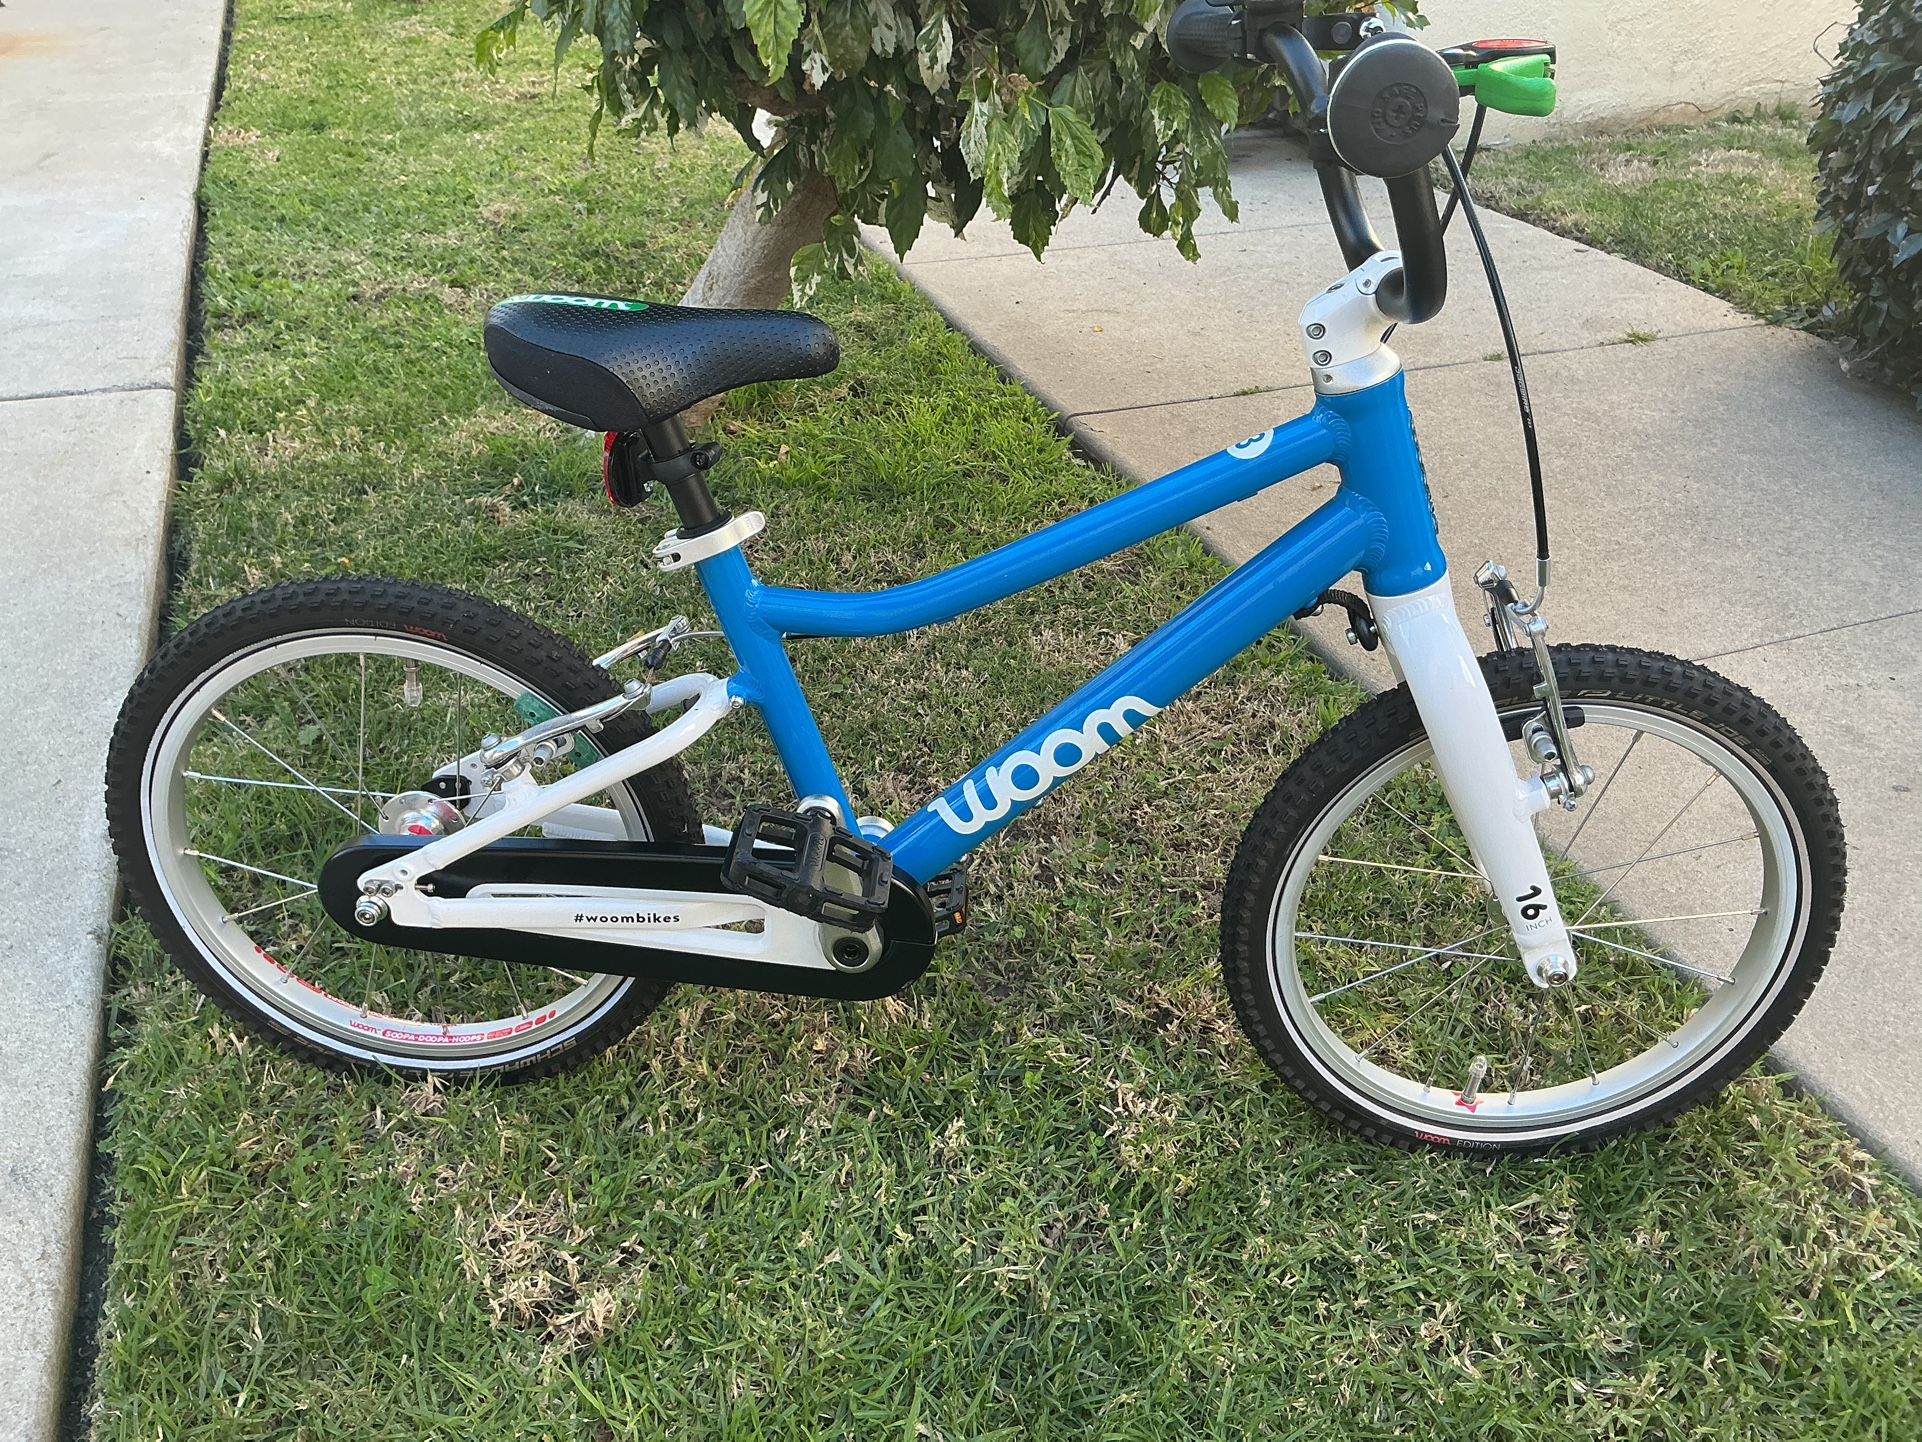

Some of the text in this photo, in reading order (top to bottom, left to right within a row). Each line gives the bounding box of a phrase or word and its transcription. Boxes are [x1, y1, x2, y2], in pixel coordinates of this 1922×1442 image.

[1615, 690, 1751, 747] LITTLE JOE
[926, 695, 1163, 835] woom
[1515, 884, 1548, 921] 16
[573, 912, 681, 924] #woombikes
[1525, 916, 1553, 932] INCH
[1456, 1139, 1501, 1151] EDITION
